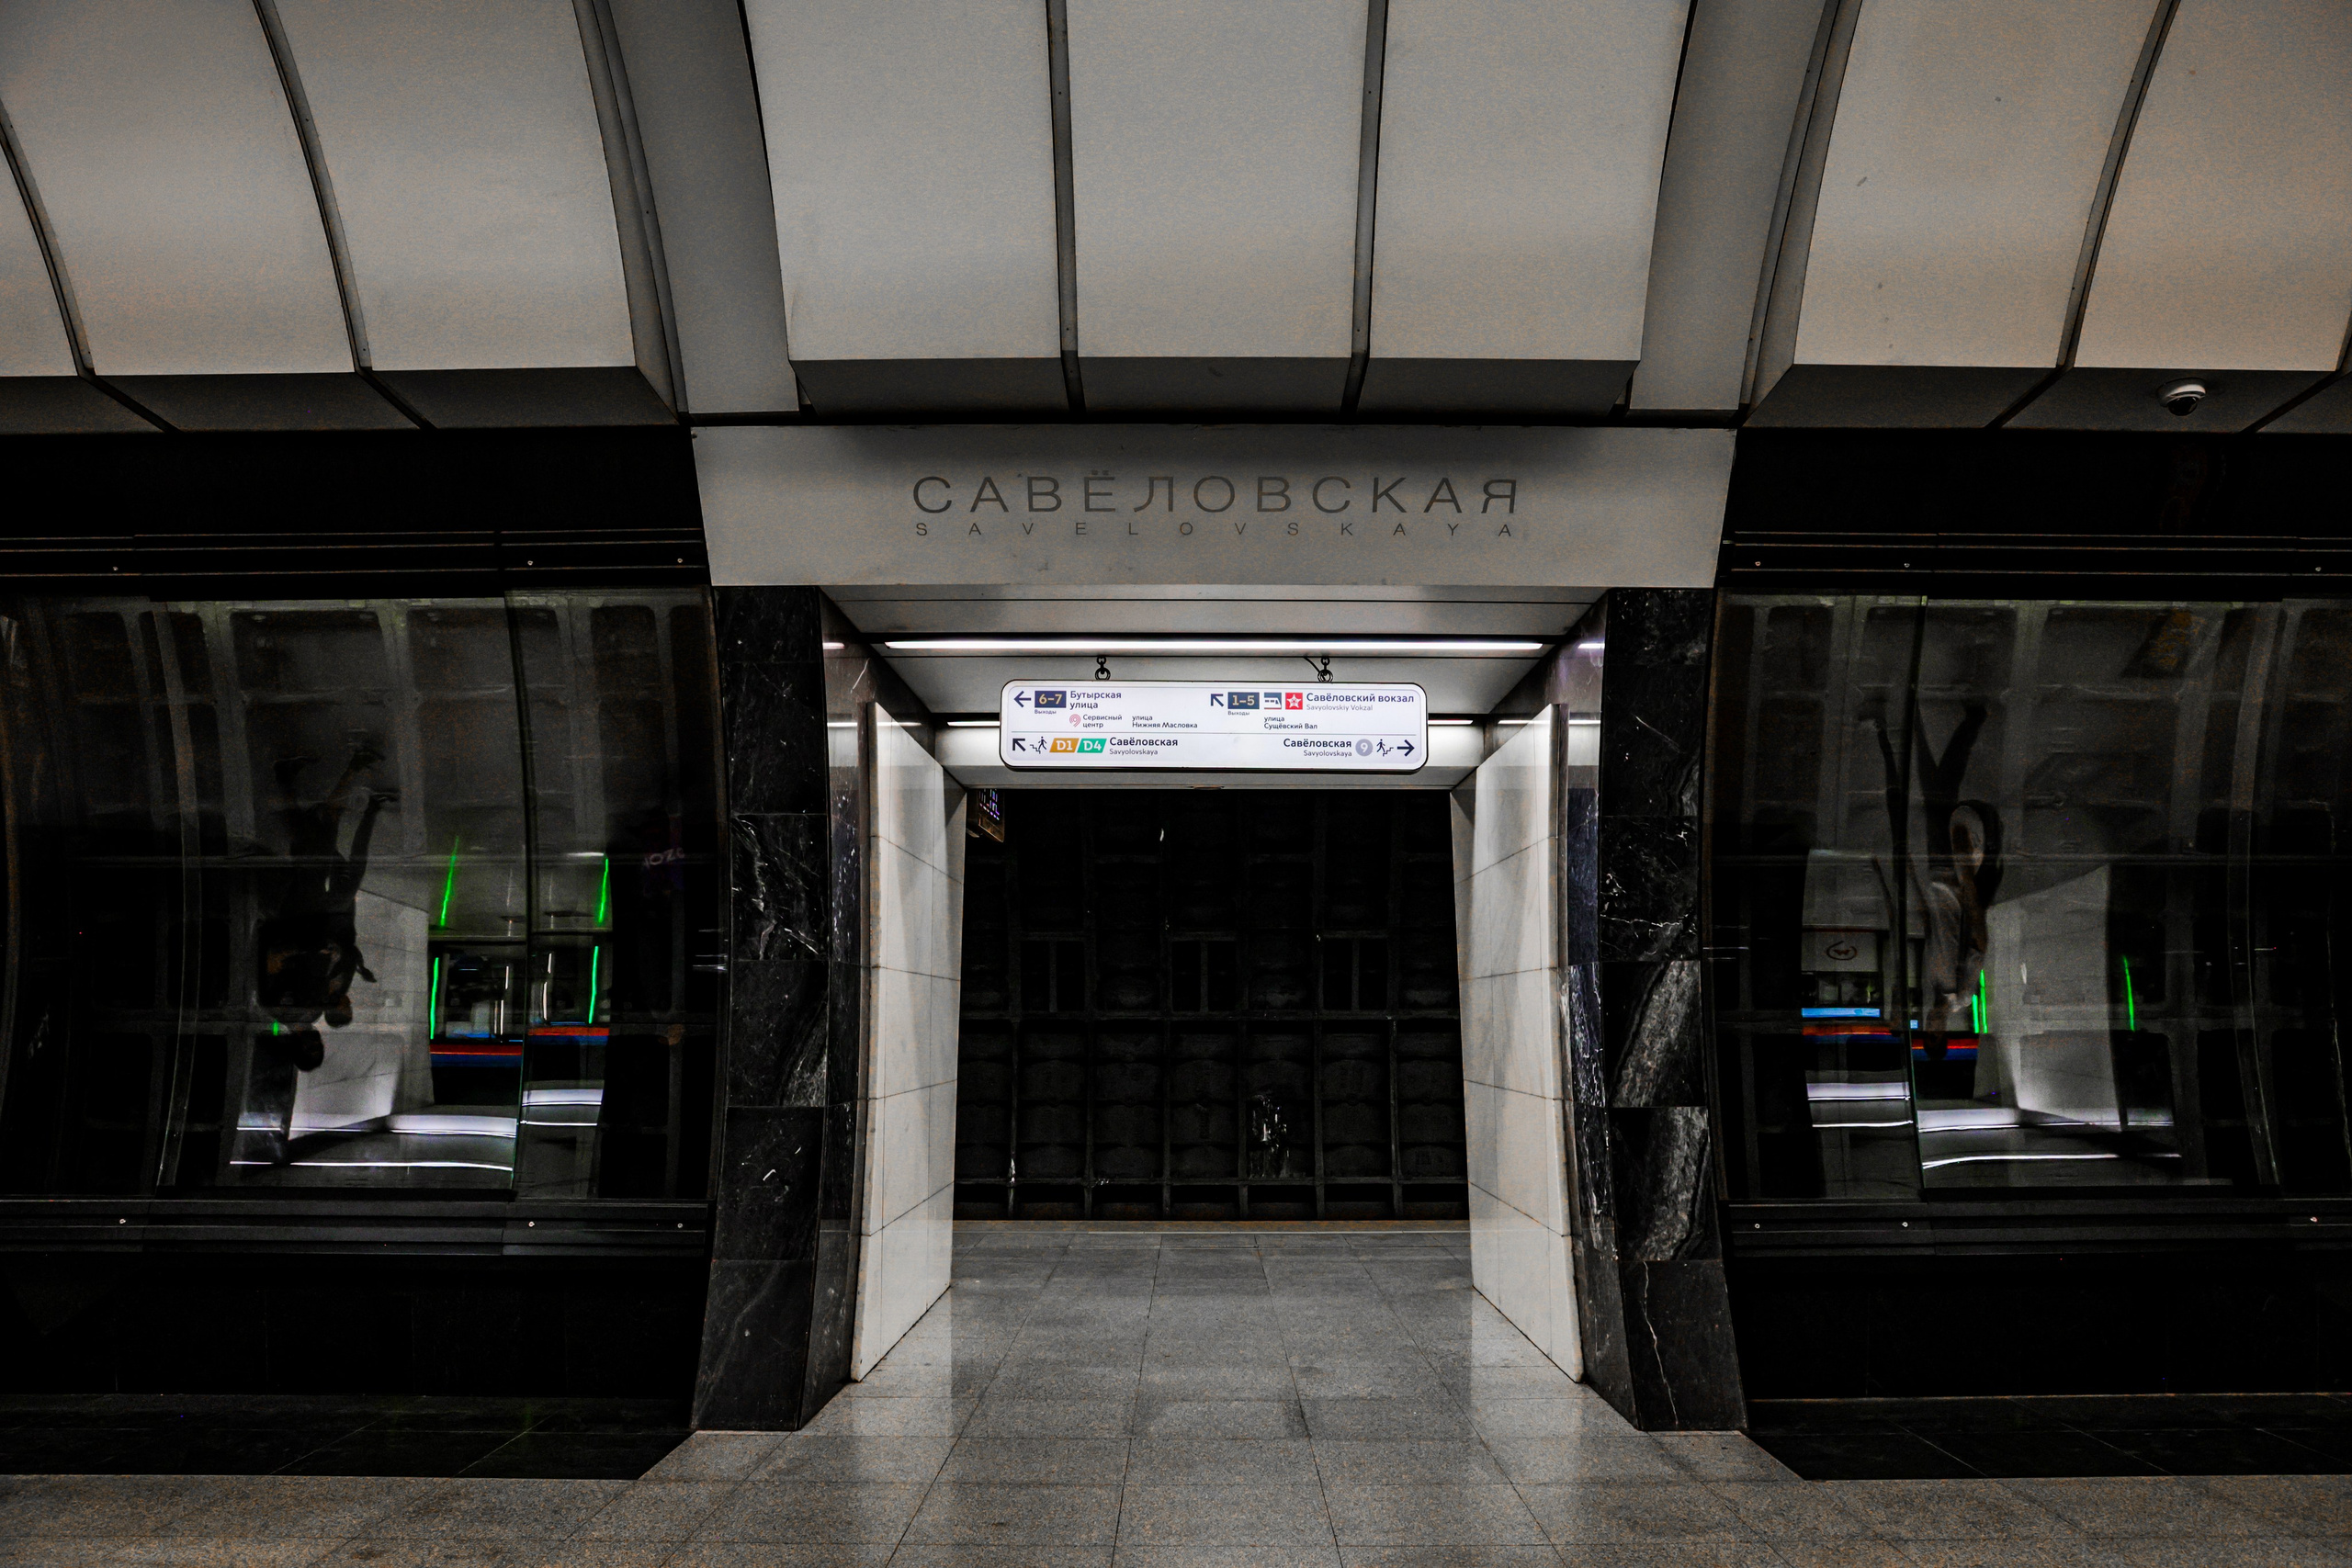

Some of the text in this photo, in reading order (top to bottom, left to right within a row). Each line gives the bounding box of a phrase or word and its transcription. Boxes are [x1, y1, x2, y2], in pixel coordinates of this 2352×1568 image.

[912, 470, 1517, 514] САВЁЛОВСКАЯ
[915, 521, 1512, 537] SAVELOVSKAYA
[1069, 690, 1122, 700] Бутырская
[1306, 693, 1375, 703] Савёловский
[1069, 702, 1099, 710] улица
[1306, 704, 1350, 712] Savyolovskiy
[1082, 714, 1123, 722] Сервисный
[1056, 739, 1073, 750] D1
[1082, 739, 1102, 751] D4
[1109, 737, 1179, 747] Савёловская
[1283, 738, 1352, 748] Савёловская
[1109, 748, 1159, 756] Savyolovskaya
[1360, 742, 1368, 753] 9
[1303, 750, 1352, 758] Savyolovskaya
